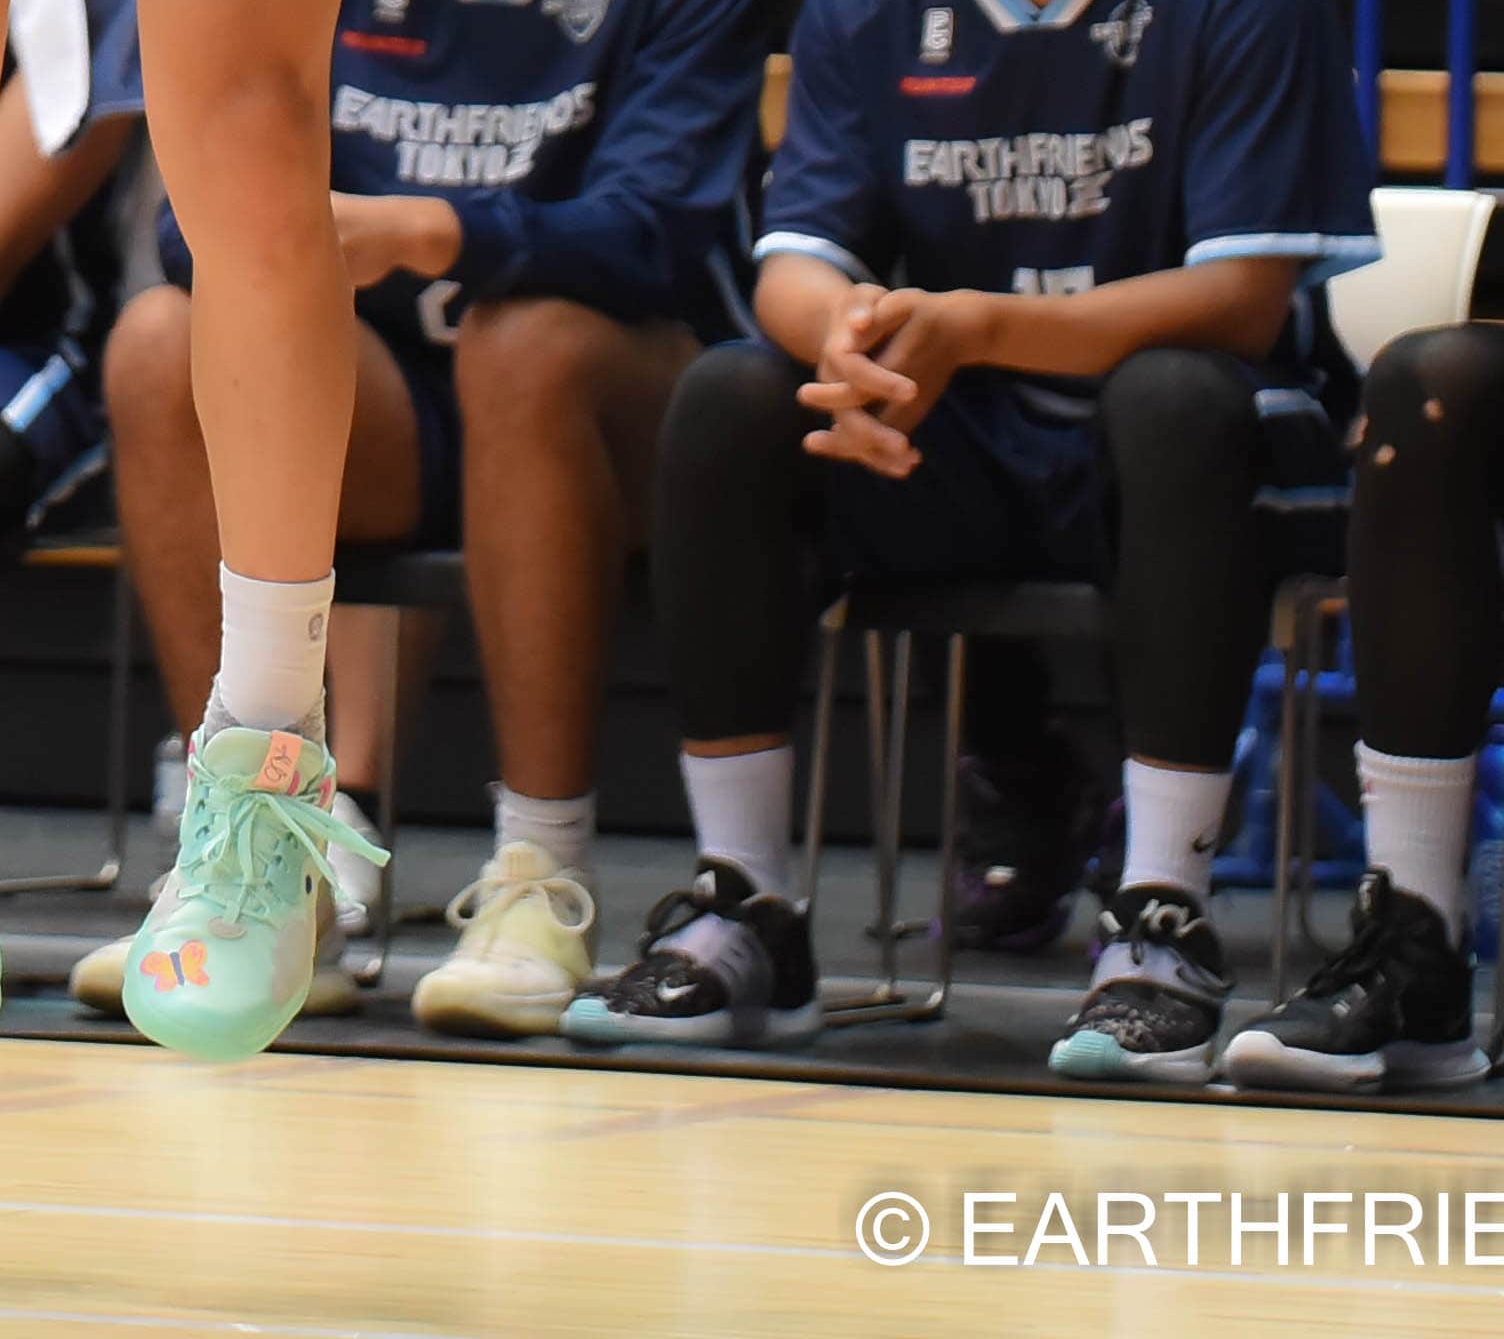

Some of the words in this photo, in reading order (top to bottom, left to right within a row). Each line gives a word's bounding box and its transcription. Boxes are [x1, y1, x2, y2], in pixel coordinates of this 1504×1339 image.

[334, 83, 598, 144] EARTHFRIENDS
[396, 139, 508, 186] TOKYO
[903, 116, 1154, 188] EARTHFRIENDS
[965, 175, 1067, 223] TOKYO
